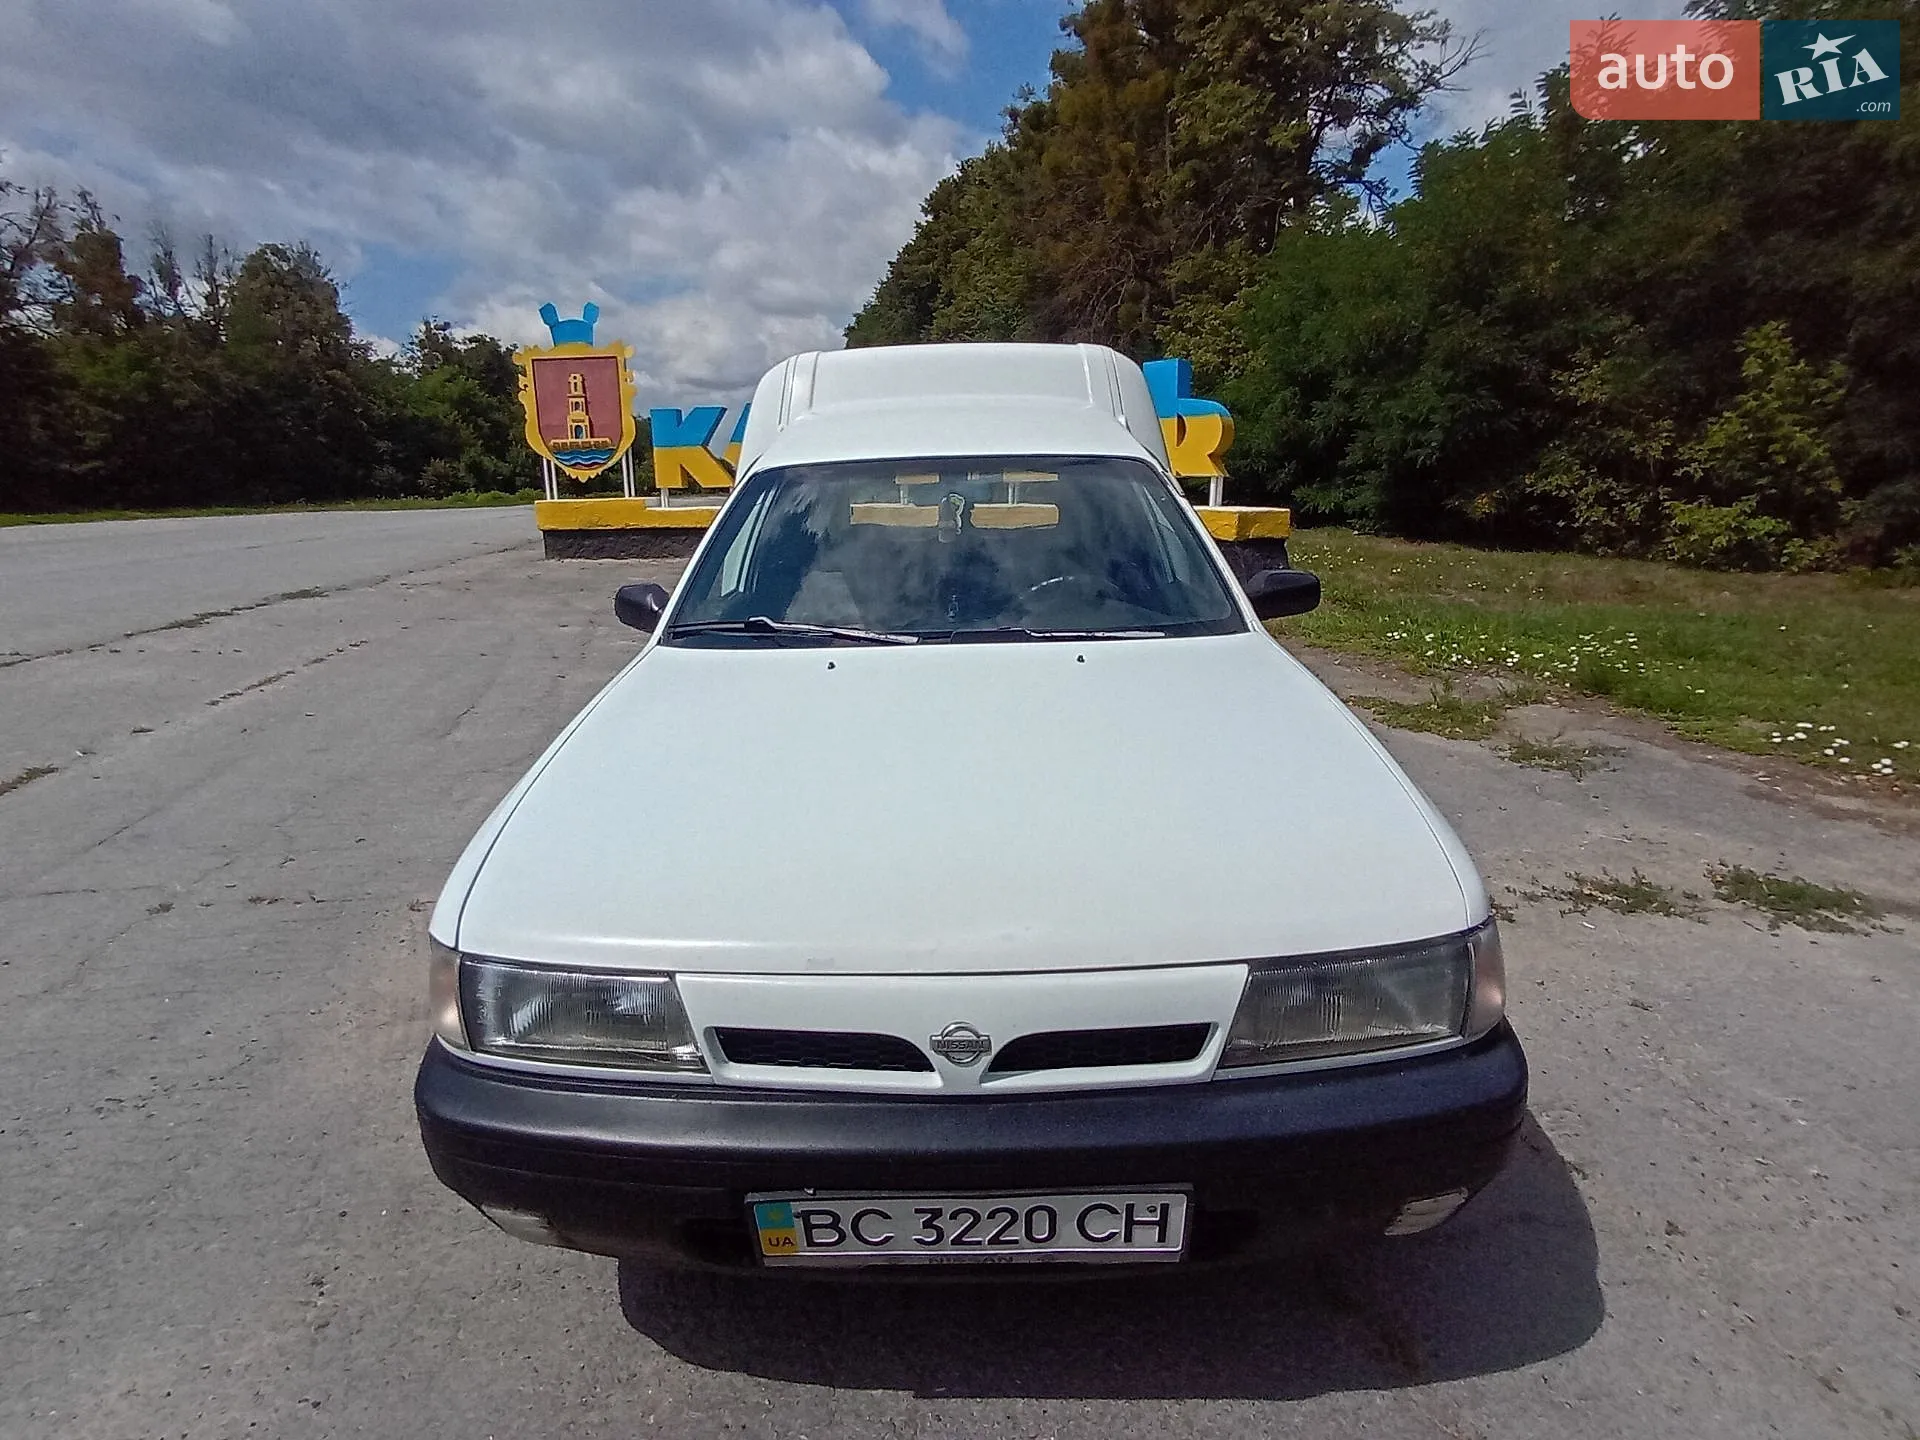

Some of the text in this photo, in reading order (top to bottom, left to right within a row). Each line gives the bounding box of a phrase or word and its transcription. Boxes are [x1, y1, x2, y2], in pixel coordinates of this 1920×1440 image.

[937, 1039, 985, 1051] NISSAN
[801, 1202, 1170, 1248] BC 3220 CH
[768, 1236, 795, 1248] UA
